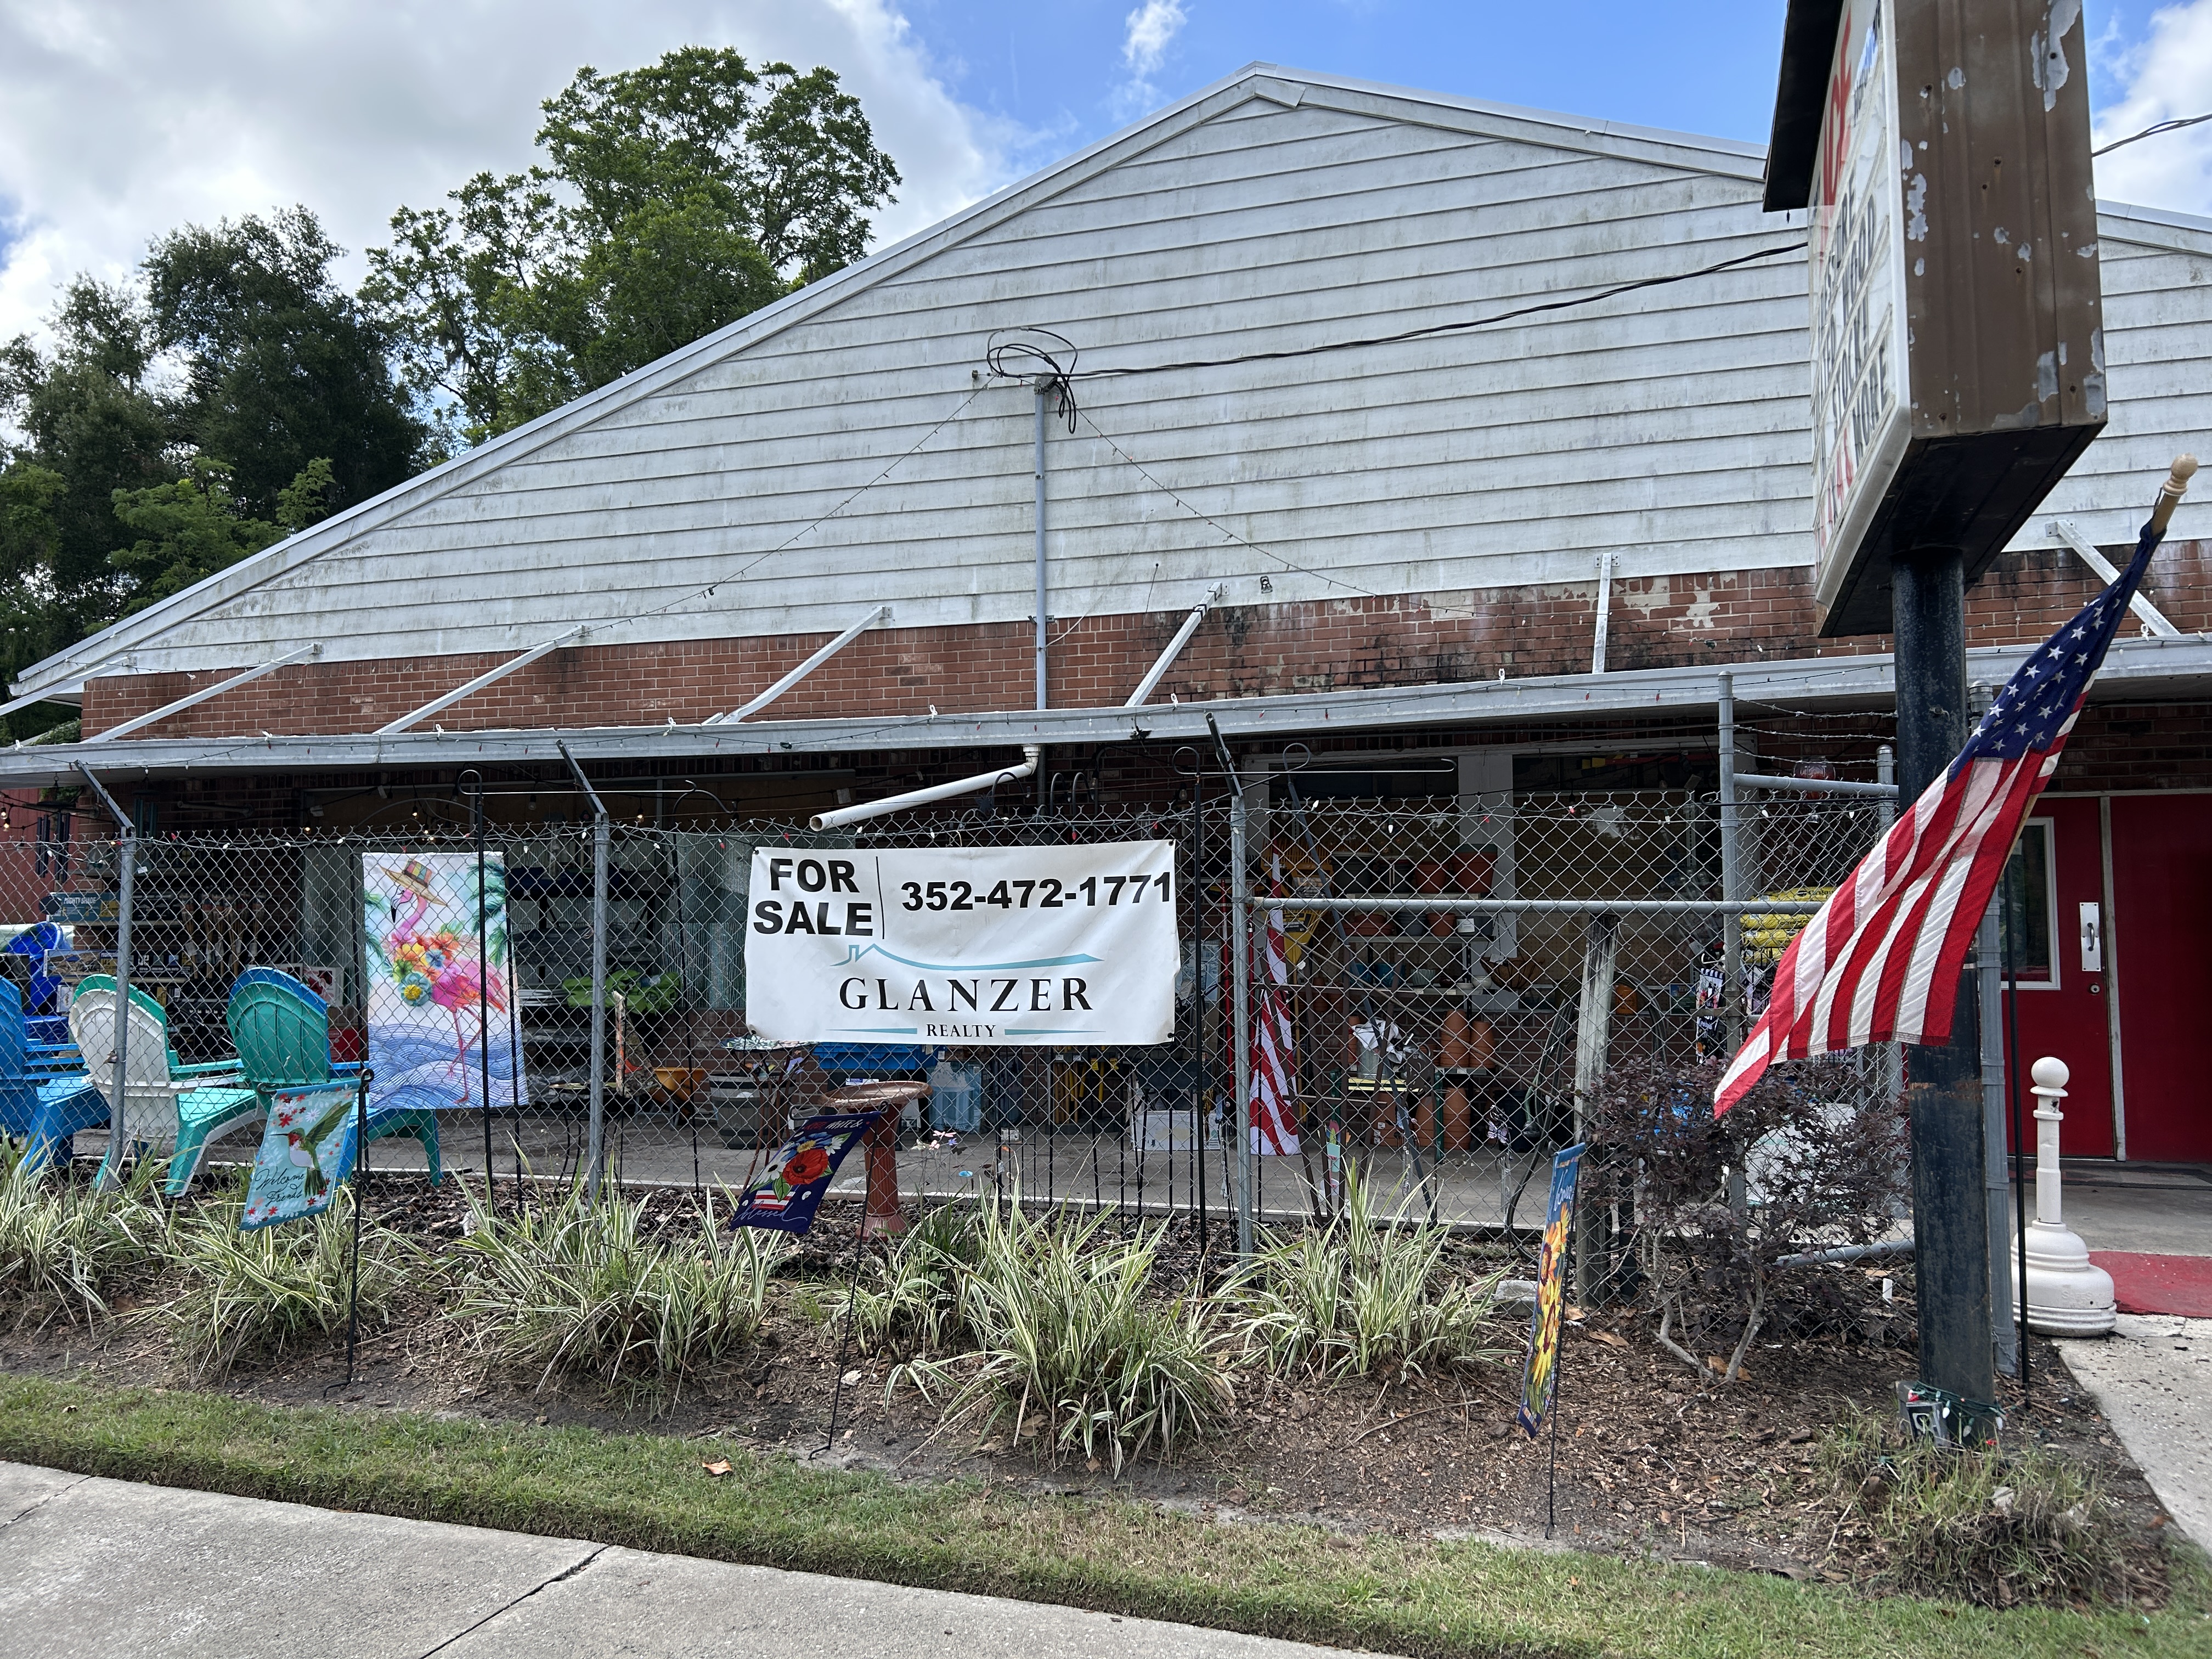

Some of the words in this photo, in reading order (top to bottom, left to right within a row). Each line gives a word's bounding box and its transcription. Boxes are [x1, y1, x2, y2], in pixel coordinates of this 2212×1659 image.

[1819, 4, 1851, 284] ACE
[1842, 194, 1875, 326] WOOD
[1853, 336, 1888, 468] MORE
[770, 858, 859, 893] FOR
[901, 872, 1171, 911] 352-472-1771
[754, 900, 873, 936] SALE
[839, 977, 1093, 1011] GLANZER
[927, 1024, 996, 1037] REALTY
[255, 1166, 304, 1190] Welcome
[266, 1182, 303, 1207] Friends
[733, 1200, 808, 1222] blessed
